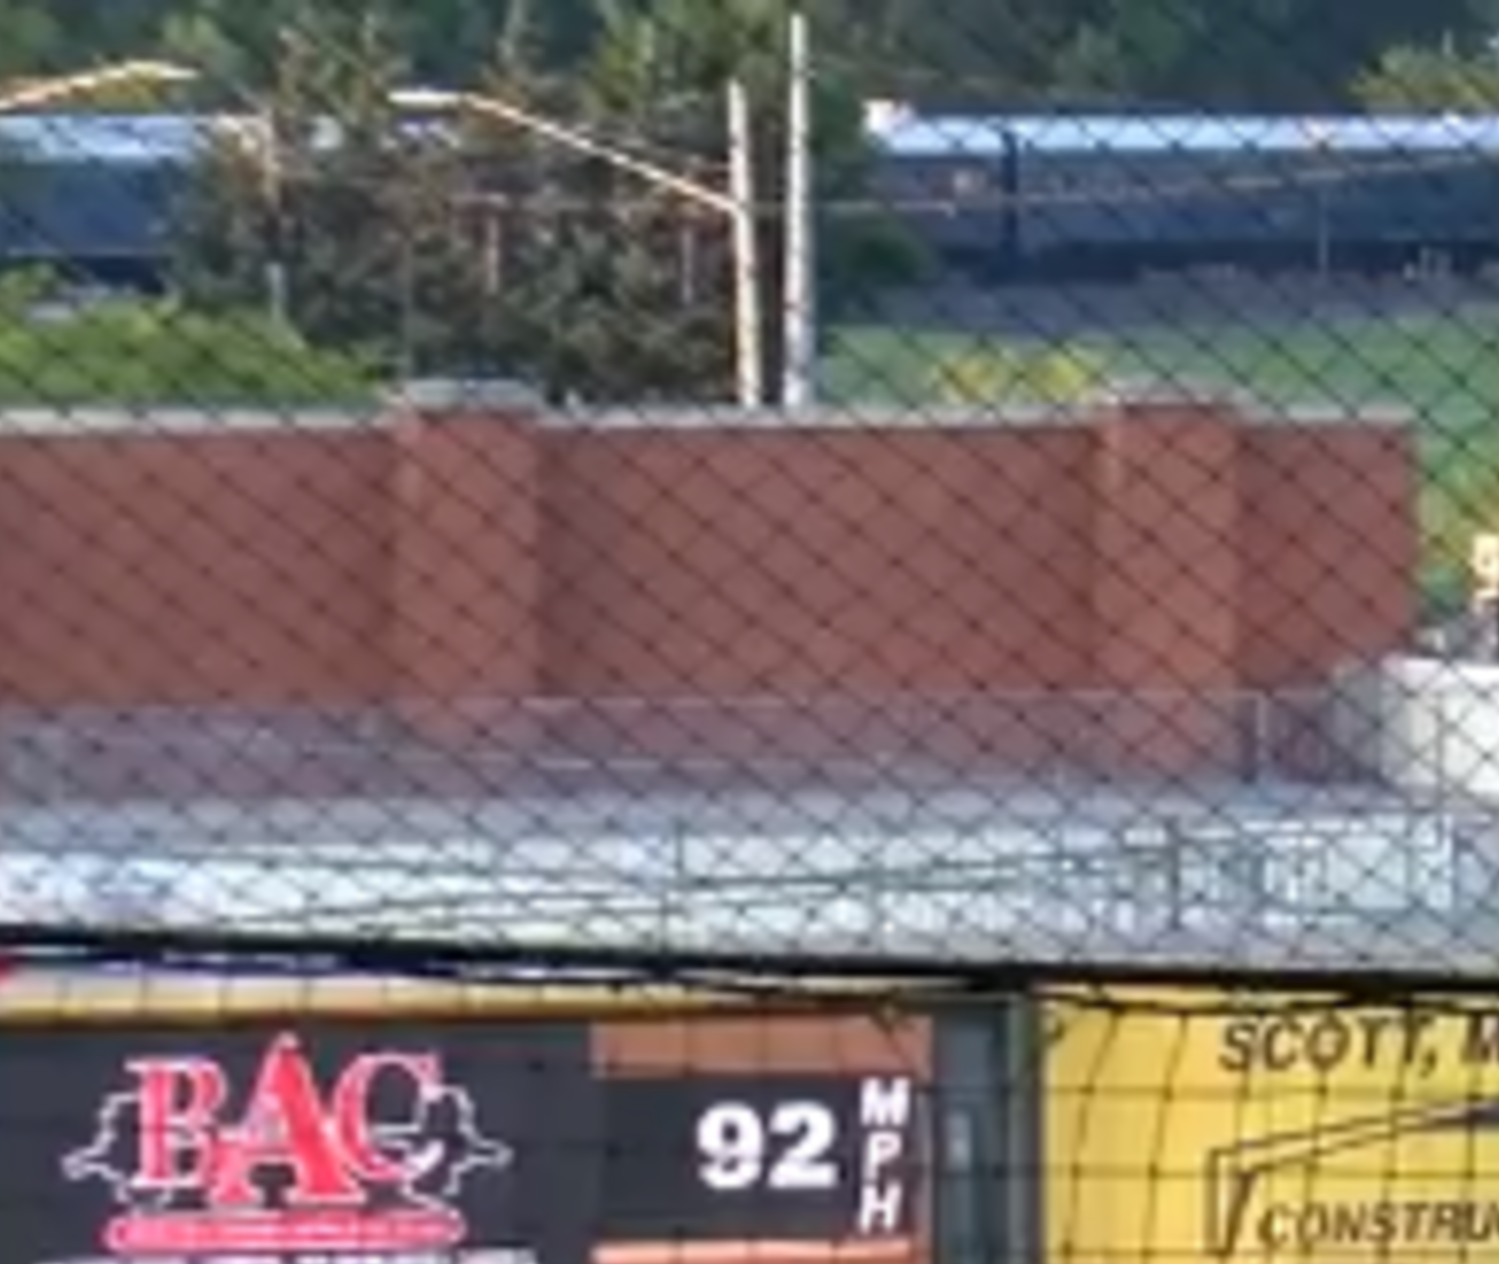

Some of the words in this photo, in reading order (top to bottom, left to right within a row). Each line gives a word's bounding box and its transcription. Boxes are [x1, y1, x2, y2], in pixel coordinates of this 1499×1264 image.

[1218, 1010, 1440, 1078] SCOTT,
[125, 1031, 444, 1207] BAC
[694, 1102, 840, 1190] 92
[856, 1077, 911, 1234] MPH
